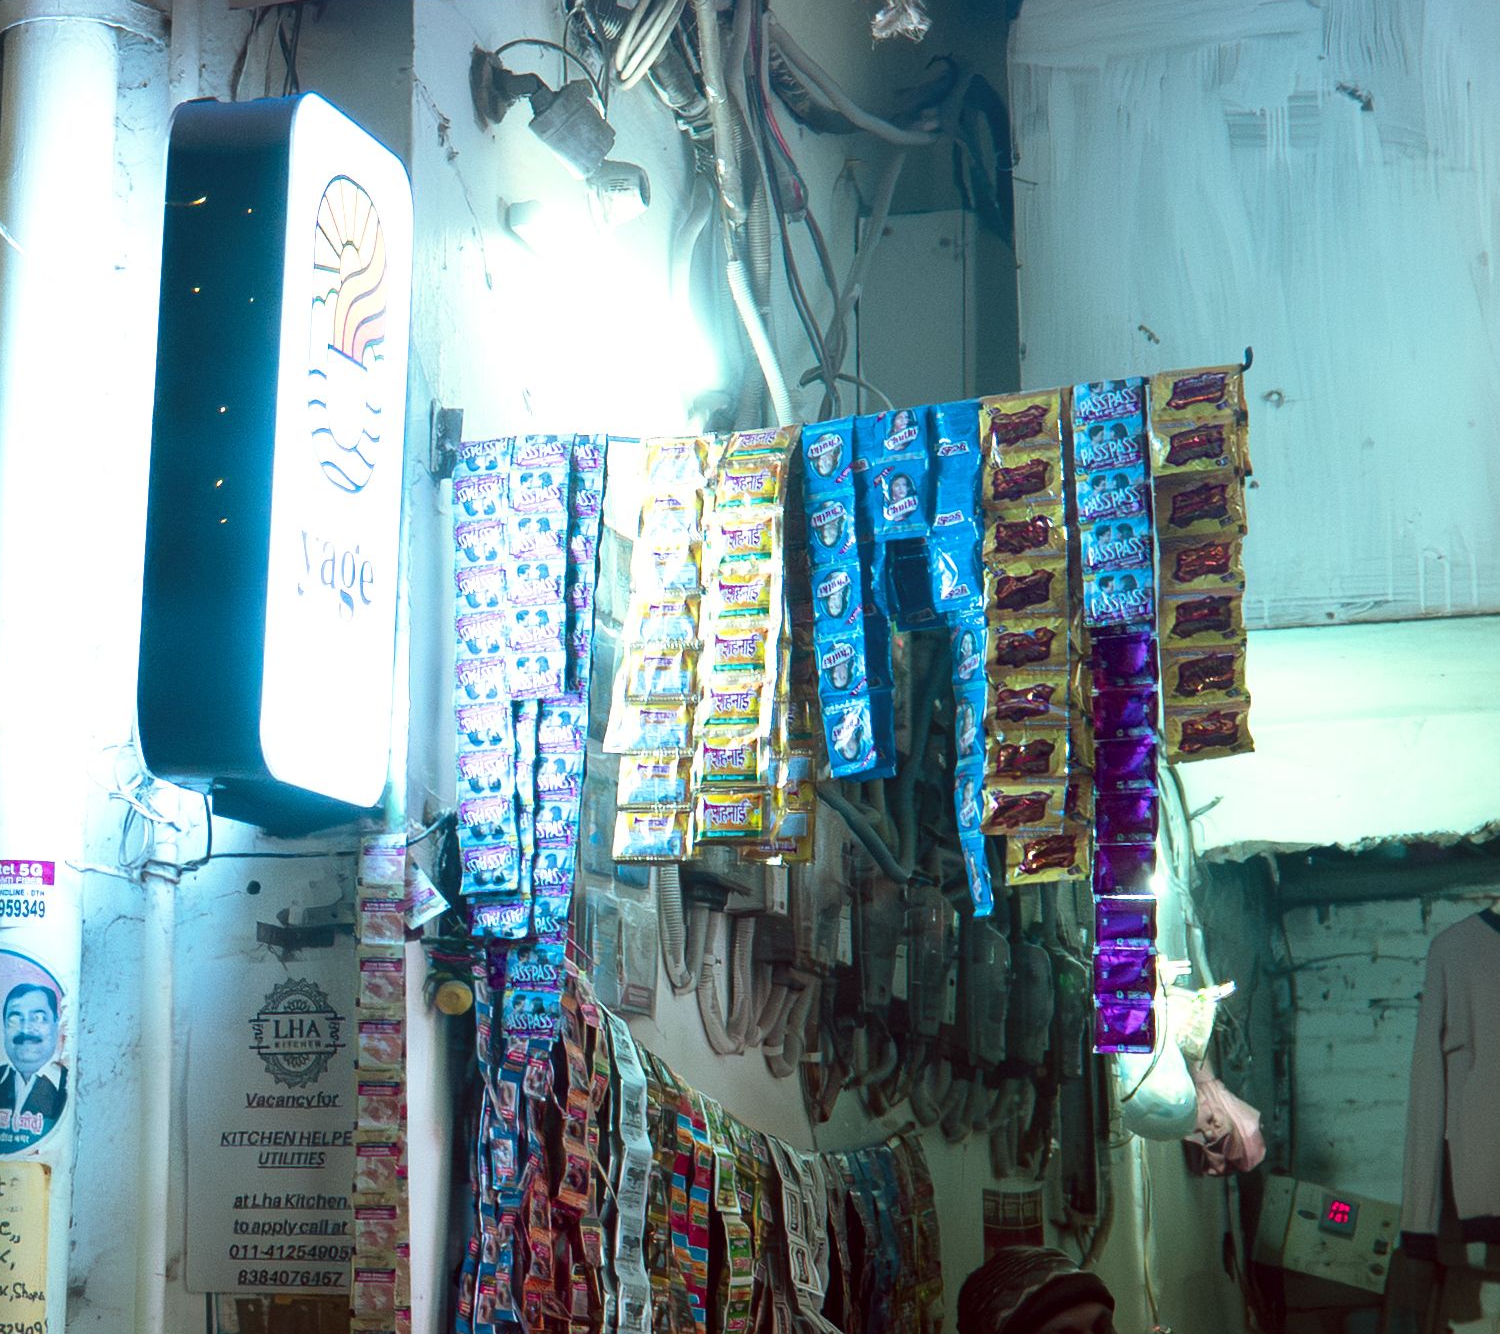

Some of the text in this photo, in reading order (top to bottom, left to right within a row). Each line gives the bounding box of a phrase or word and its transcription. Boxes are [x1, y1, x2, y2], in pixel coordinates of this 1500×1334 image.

[273, 1019, 322, 1039] LHA
[245, 1091, 339, 1109] Vacancy for
[220, 1130, 354, 1147] KITCHEN HELPE
[258, 1151, 326, 1166] UTILITIES
[234, 1193, 281, 1209] at Lha
[233, 1219, 348, 1238] to apply call at
